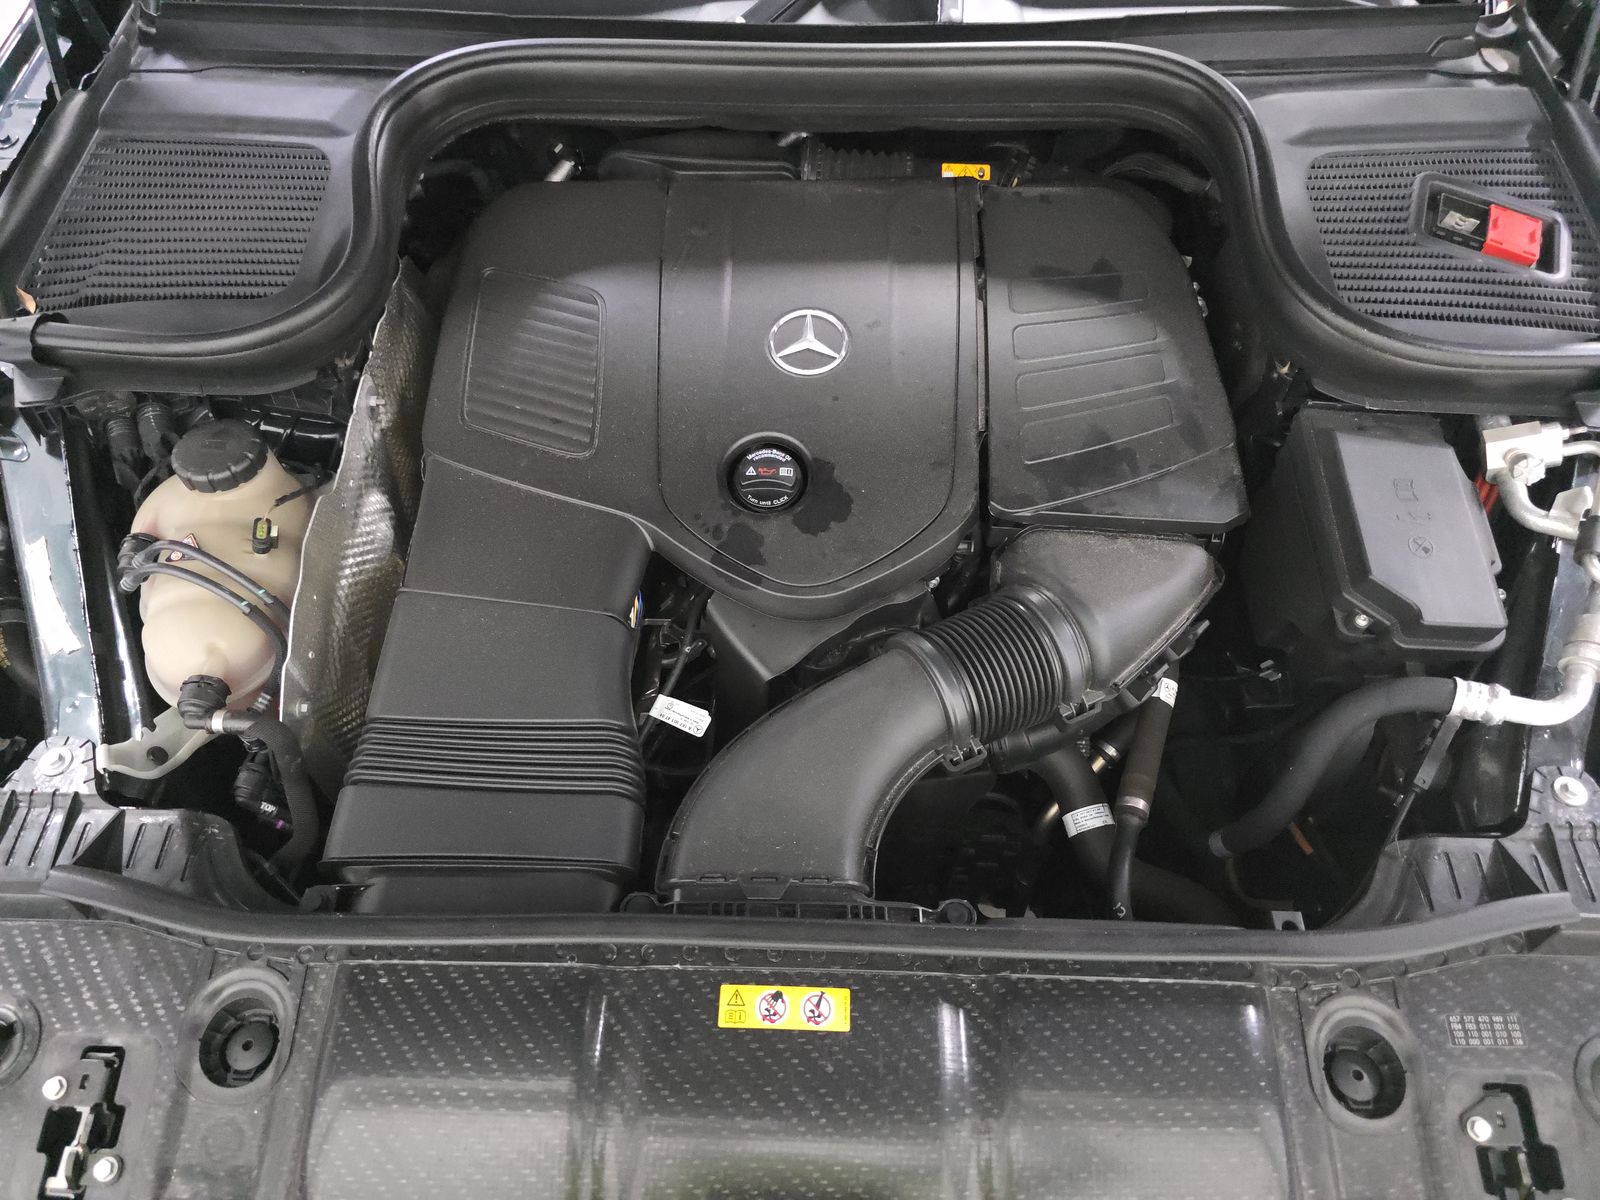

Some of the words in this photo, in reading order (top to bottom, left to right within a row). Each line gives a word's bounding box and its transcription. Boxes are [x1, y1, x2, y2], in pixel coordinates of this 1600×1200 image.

[747, 494, 759, 504] Turn
[773, 495, 789, 505] CLICK
[260, 801, 276, 813] TOP
